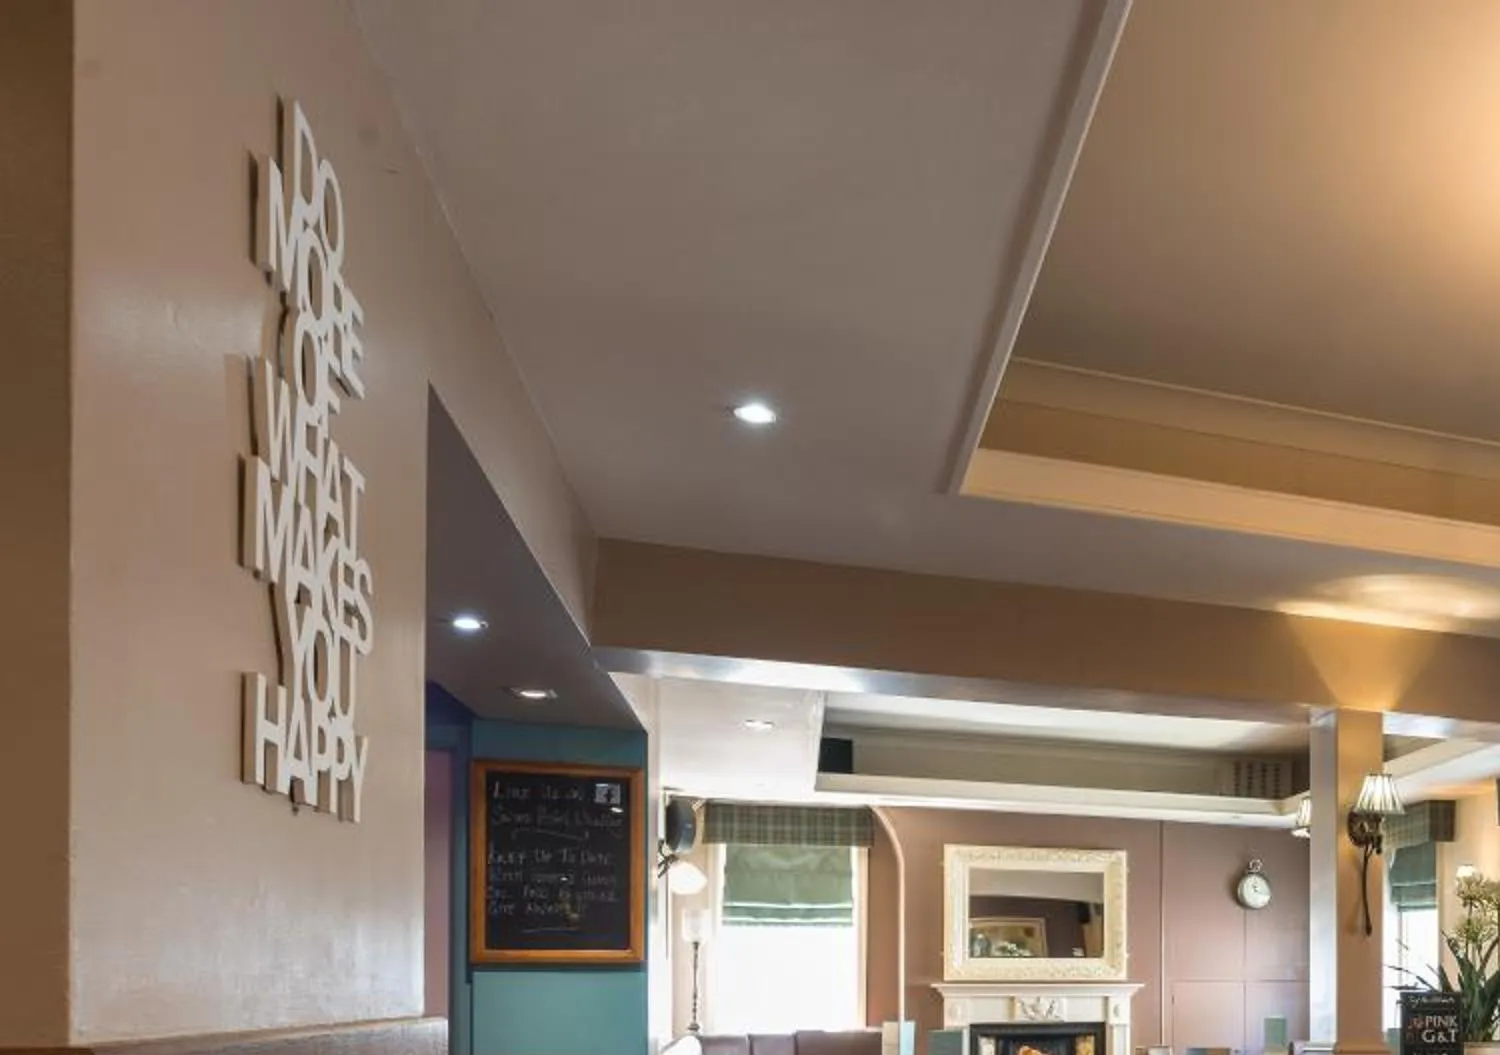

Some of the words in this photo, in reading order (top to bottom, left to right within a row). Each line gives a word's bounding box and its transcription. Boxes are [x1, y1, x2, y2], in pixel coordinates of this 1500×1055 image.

[293, 99, 344, 271] DO
[268, 156, 364, 400] MORE
[294, 307, 341, 440] OF
[265, 356, 366, 552] WHAT
[255, 455, 374, 656] MAKES
[285, 595, 356, 727] YOU
[255, 671, 369, 823] HAPPY
[1421, 1029, 1459, 1043] G&T
[1425, 1015, 1458, 1028] PINK
